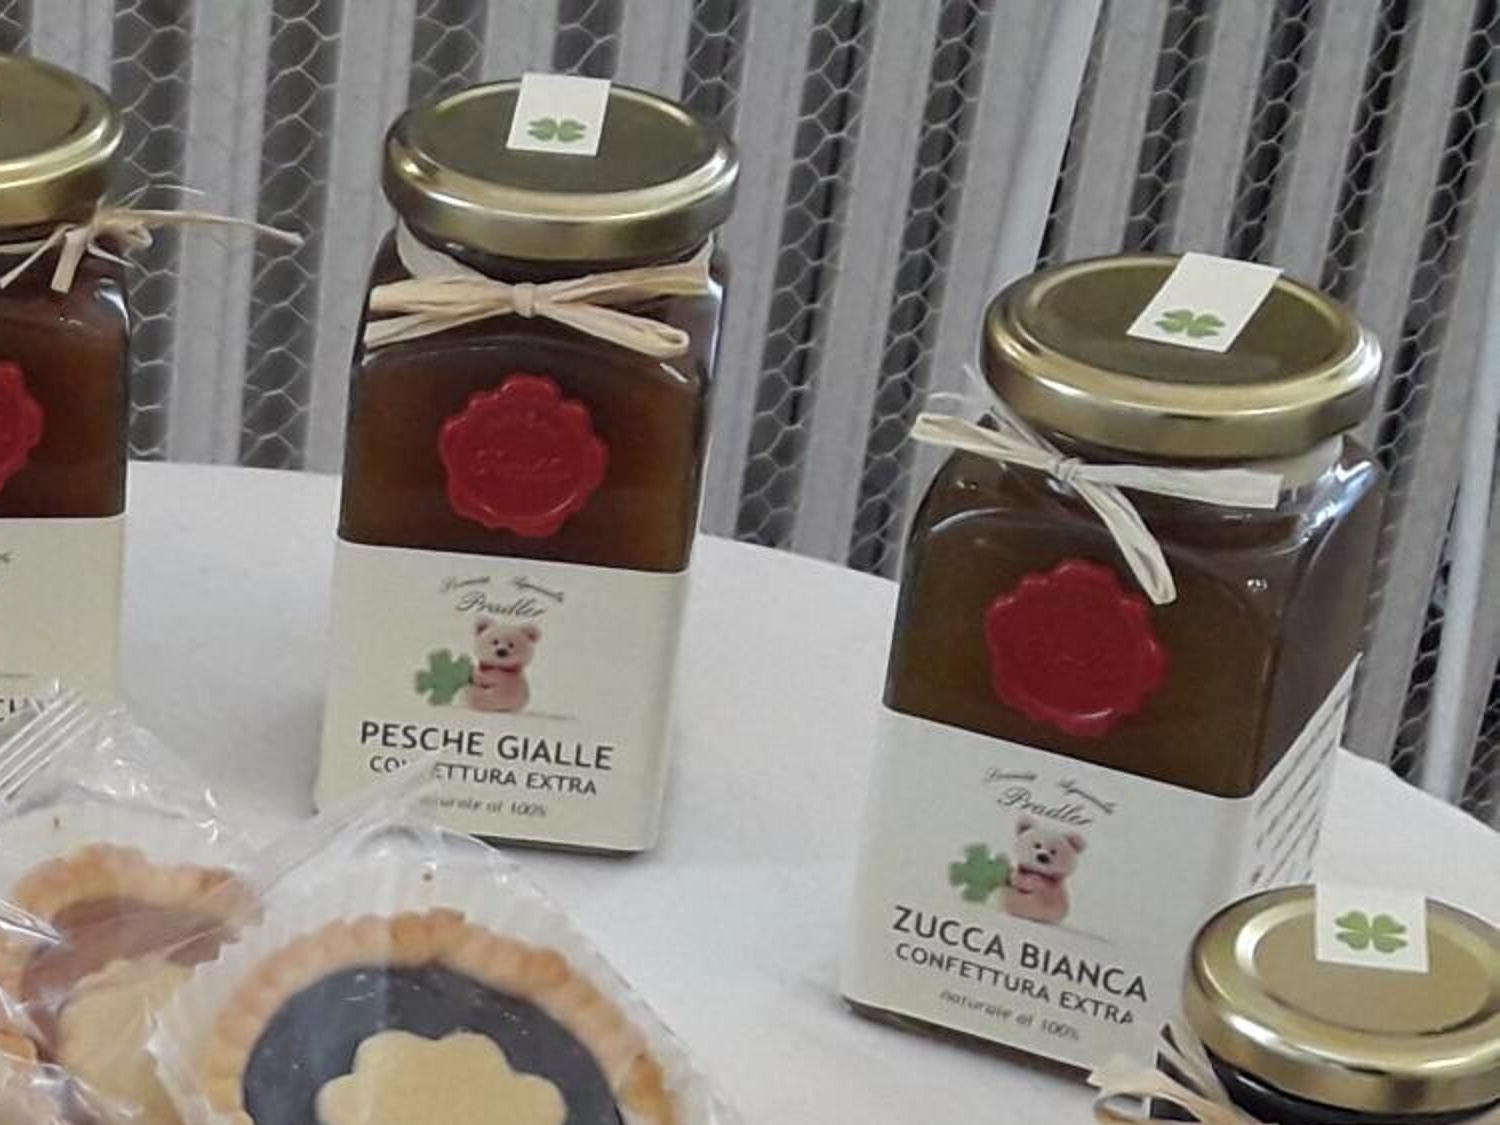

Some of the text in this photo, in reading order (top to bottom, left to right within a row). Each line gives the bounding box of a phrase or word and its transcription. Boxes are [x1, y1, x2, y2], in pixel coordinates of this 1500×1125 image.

[361, 721, 614, 770] PESCHE GIALLE
[369, 755, 597, 796] COETTURA EXTRA
[893, 905, 1148, 1002] ZUCCA BIANCA
[896, 943, 1134, 1025] CONFETTURA EXTRA
[939, 989, 1013, 1020] naturale
